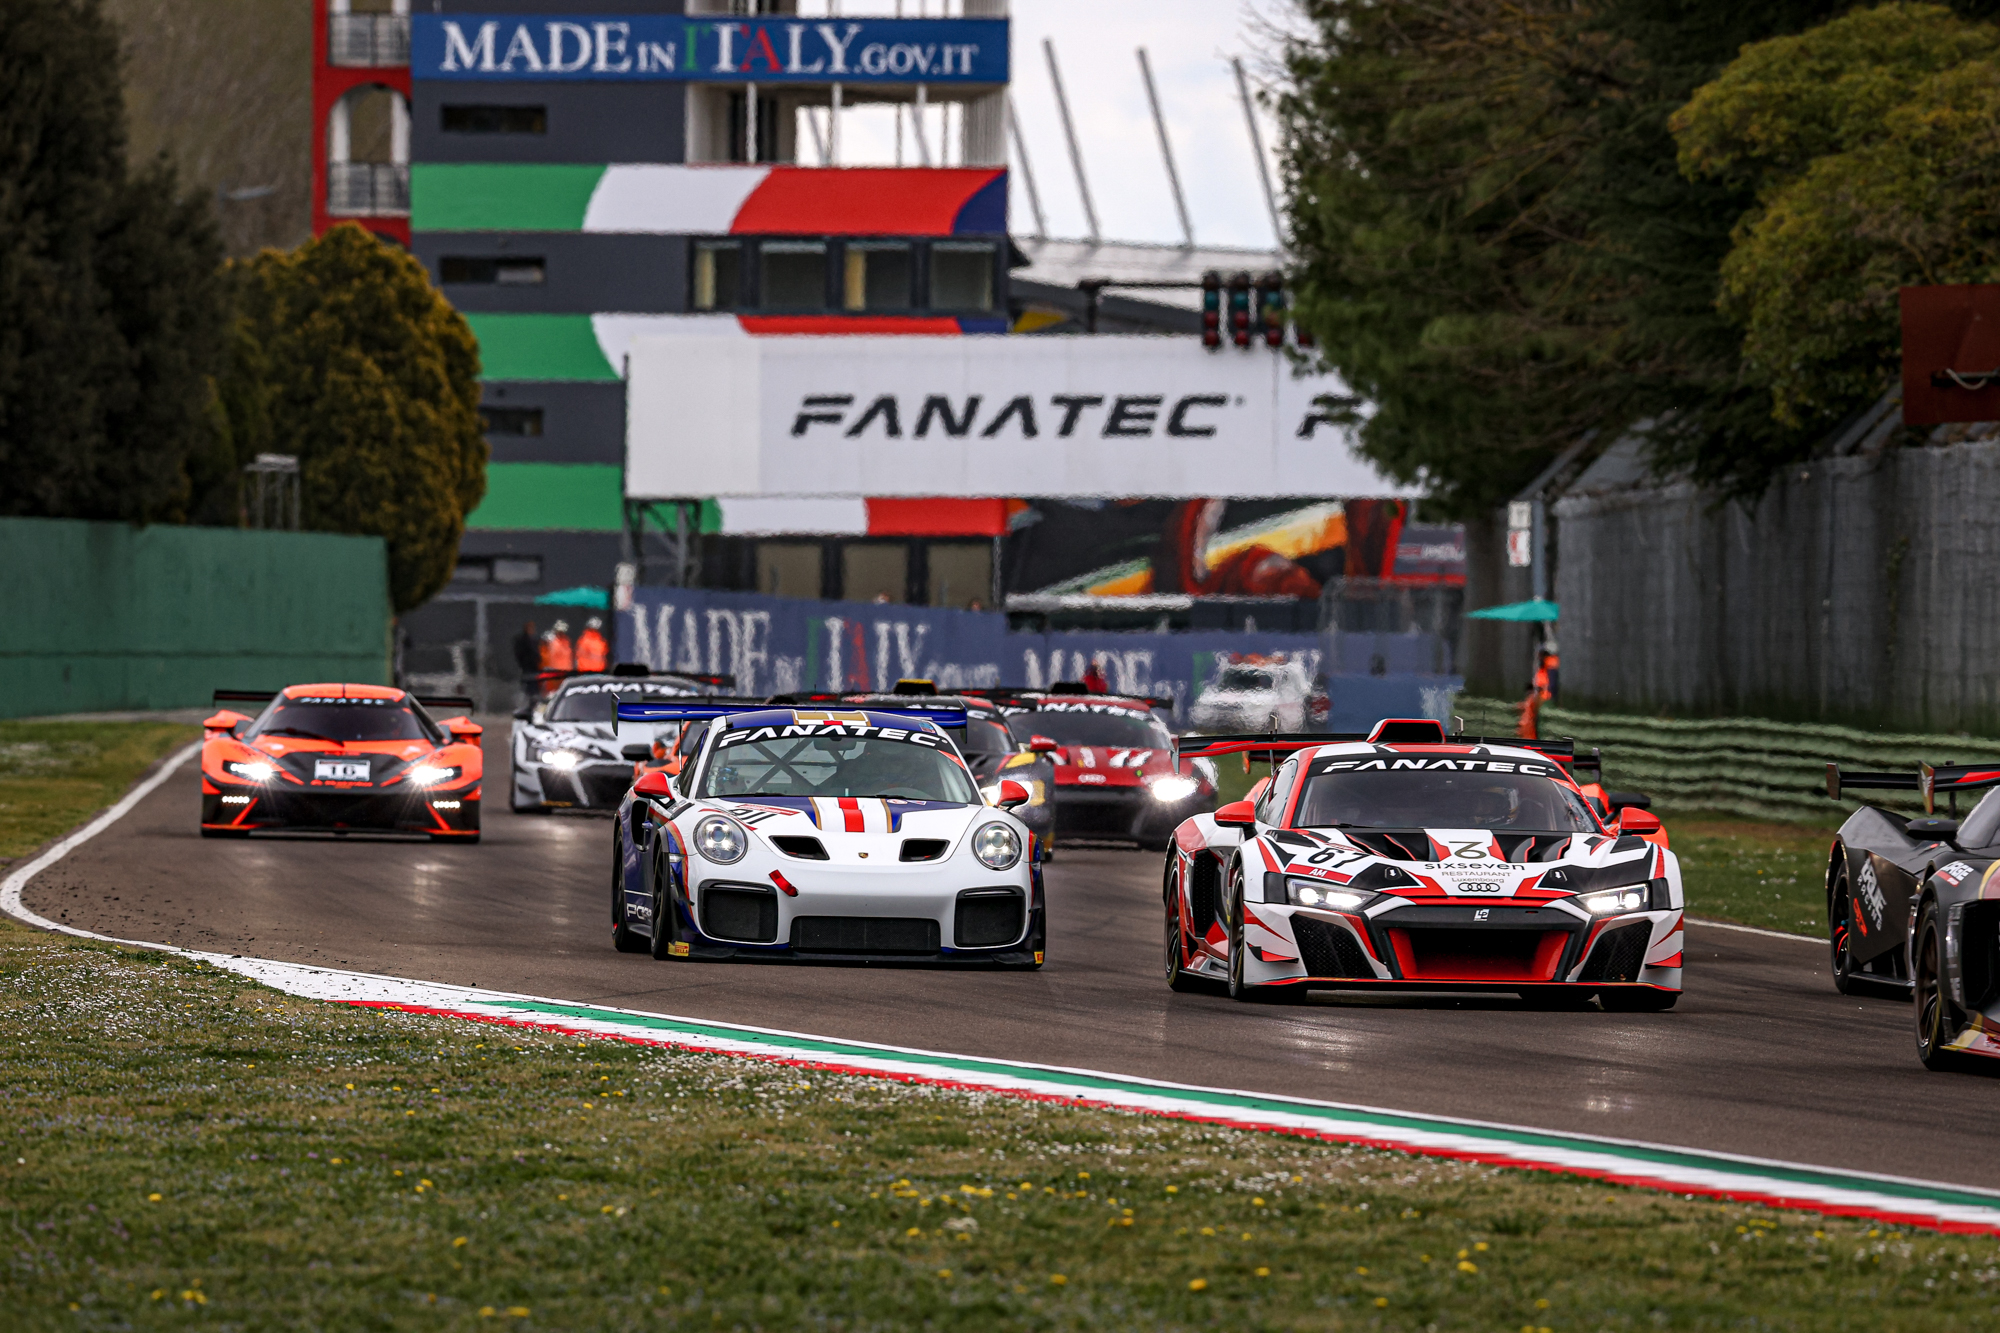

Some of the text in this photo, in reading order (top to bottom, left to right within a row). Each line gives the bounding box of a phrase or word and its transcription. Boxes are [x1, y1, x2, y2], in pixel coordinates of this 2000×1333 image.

[439, 21, 632, 72] MADE
[637, 42, 676, 73] IN
[791, 394, 1229, 439] FANATEC
[718, 725, 943, 748] FANATEC
[1322, 759, 1548, 776] FANATEC
[1307, 847, 1370, 869] 67
[1424, 862, 1526, 871] sixseven
[1308, 867, 1329, 878] AM
